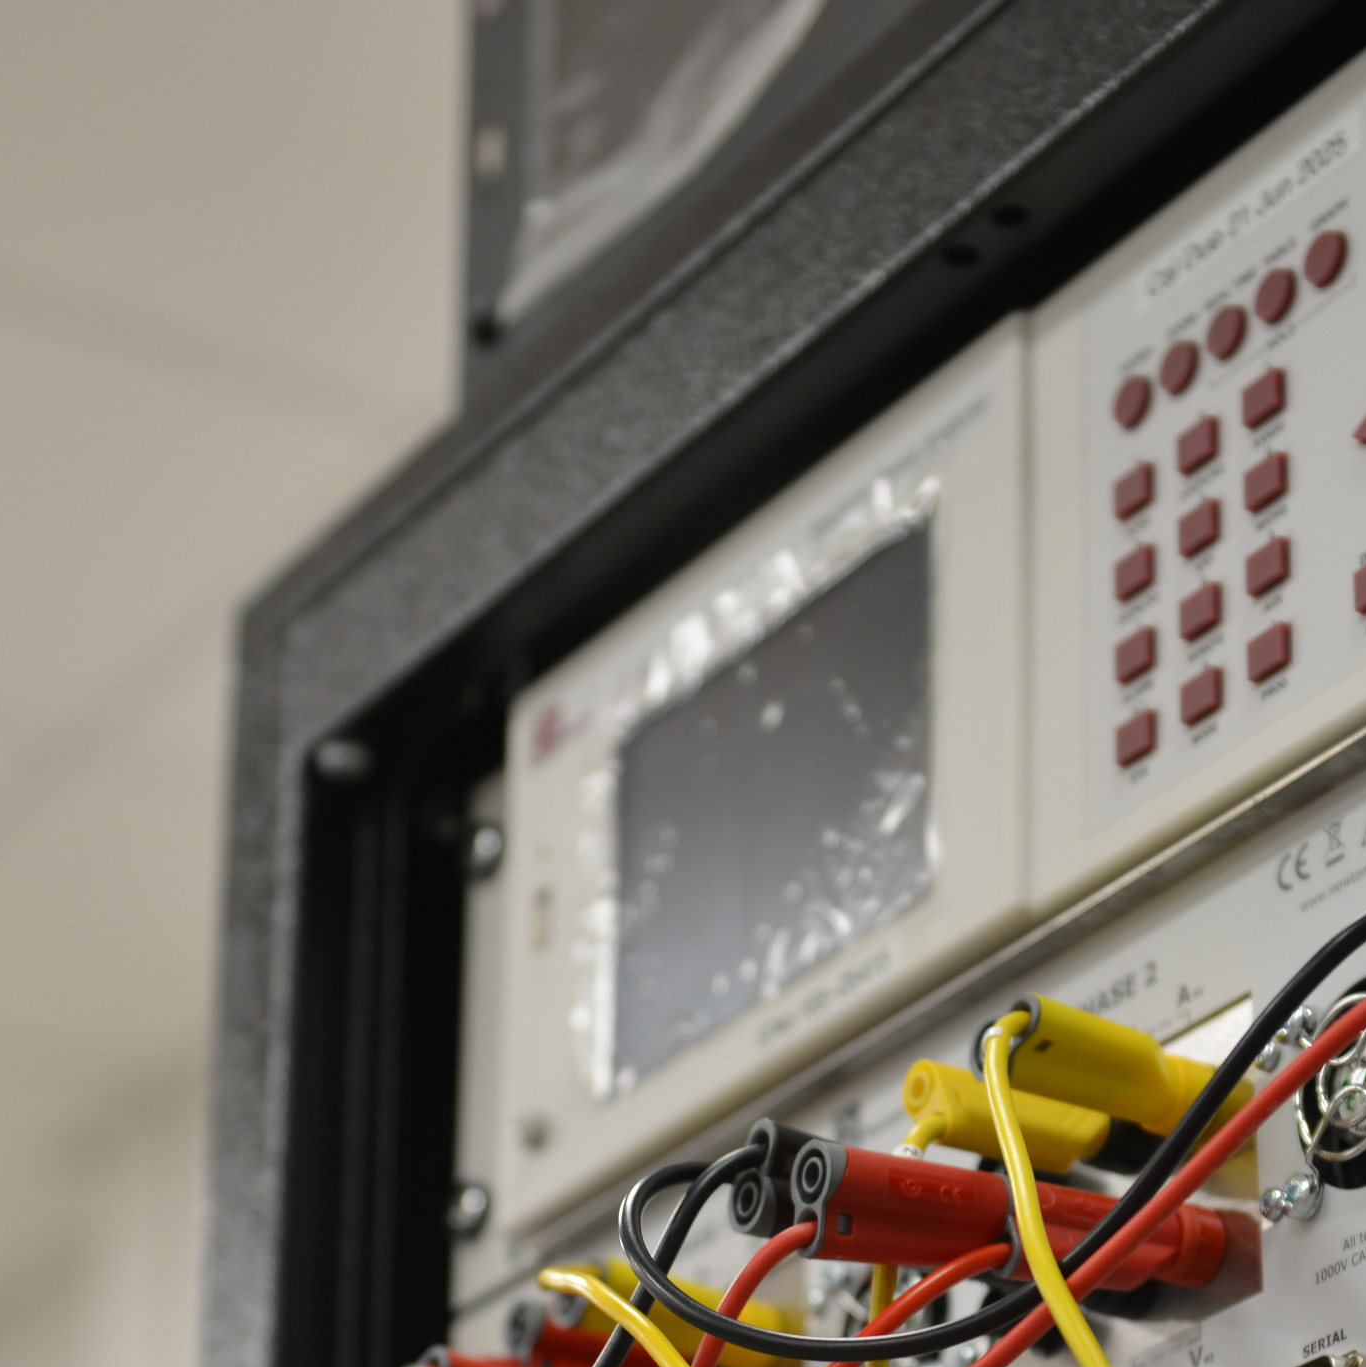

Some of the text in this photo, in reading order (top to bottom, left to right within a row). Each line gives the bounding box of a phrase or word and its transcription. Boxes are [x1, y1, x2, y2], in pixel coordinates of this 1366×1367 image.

[1342, 1236, 1356, 1252] All
[1315, 1257, 1348, 1285] 1000V
[1302, 1328, 1347, 1359] SERIAL
